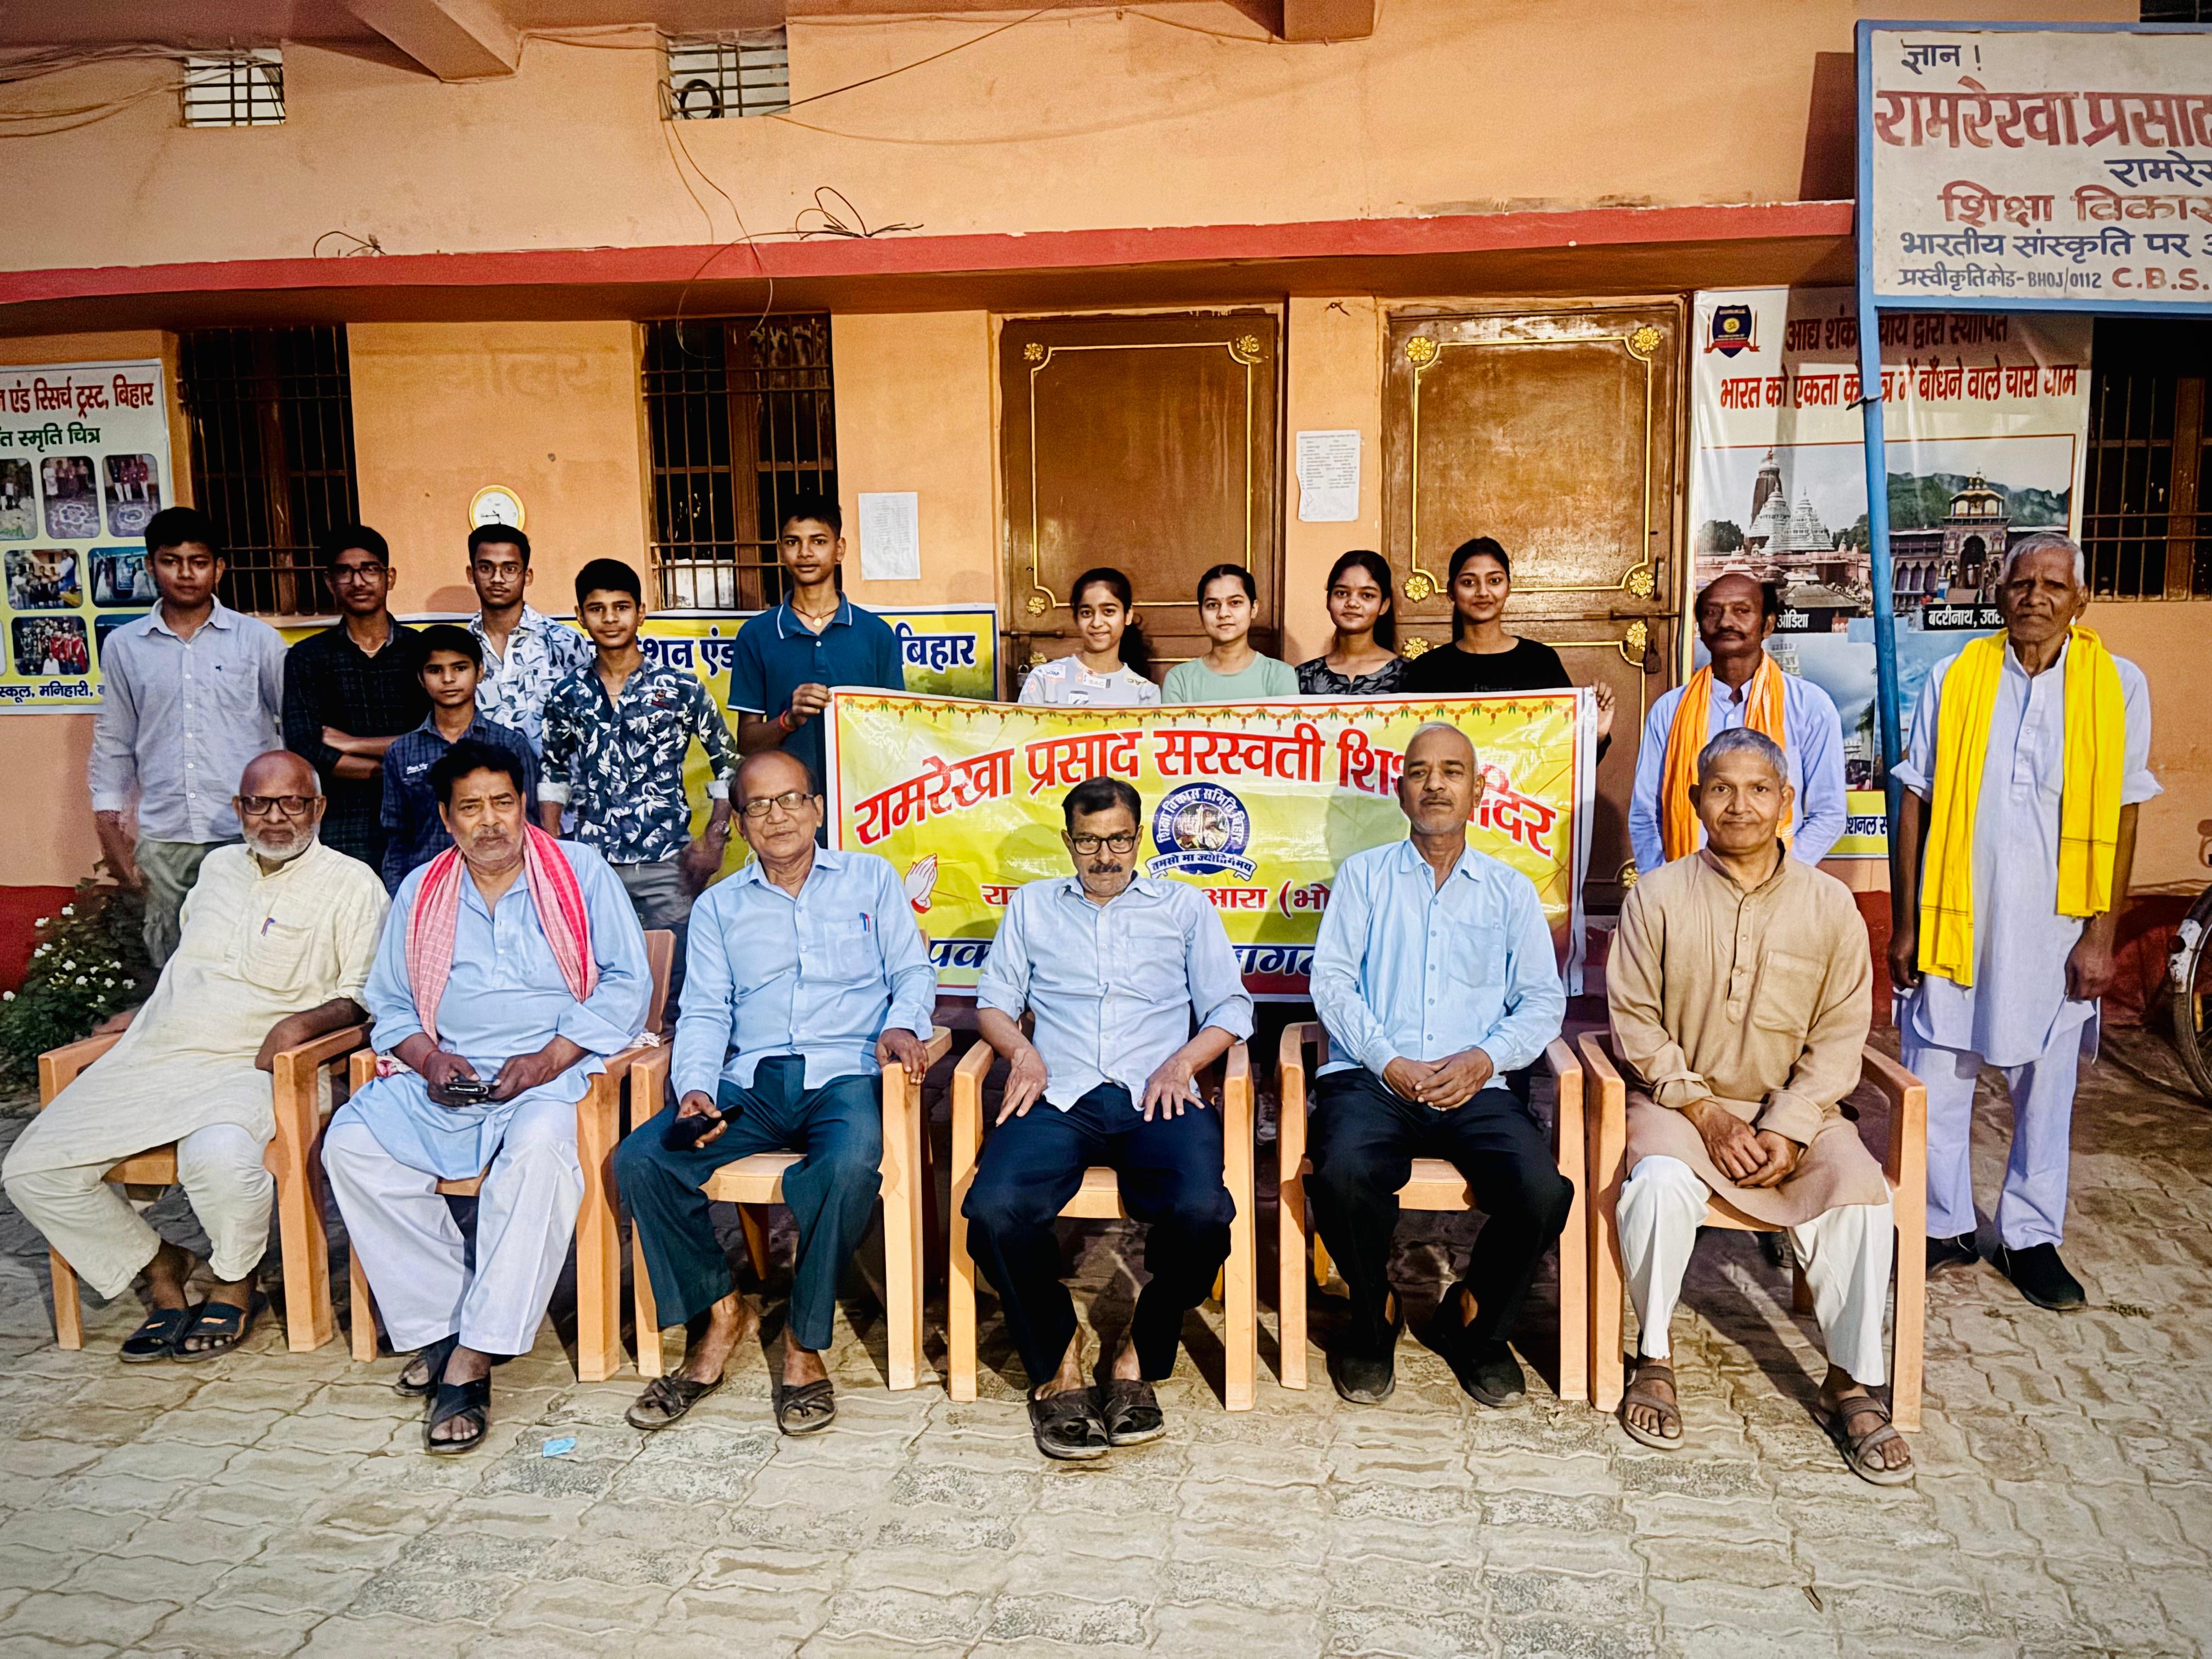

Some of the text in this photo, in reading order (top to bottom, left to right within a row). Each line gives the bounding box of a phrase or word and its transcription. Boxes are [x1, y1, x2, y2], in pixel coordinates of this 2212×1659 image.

[1901, 41, 1961, 75] ज्ञान
[1937, 179, 2055, 227] शिक्षा
[1900, 227, 2006, 257] भारतीय
[2012, 226, 2136, 263] सांस्कृति
[2143, 234, 2192, 258] पर
[2028, 267, 2102, 293] BHOJ/0112
[8, 379, 31, 413] एंड
[33, 376, 72, 411] रिसर्च
[112, 374, 154, 409] बिहार
[1720, 377, 1762, 409] भारत
[1765, 362, 1789, 408] को
[1793, 374, 1840, 409] एकता
[1967, 353, 2002, 401] वाले
[18, 422, 63, 453] स्मृति
[67, 421, 101, 444] चित्र
[1776, 608, 1810, 629] ओडिशा
[854, 748, 1015, 845] रामरेखा
[1025, 731, 1143, 795] प्रसाद
[1153, 722, 1326, 783] सरस्वती
[1161, 787, 1201, 814] विकास
